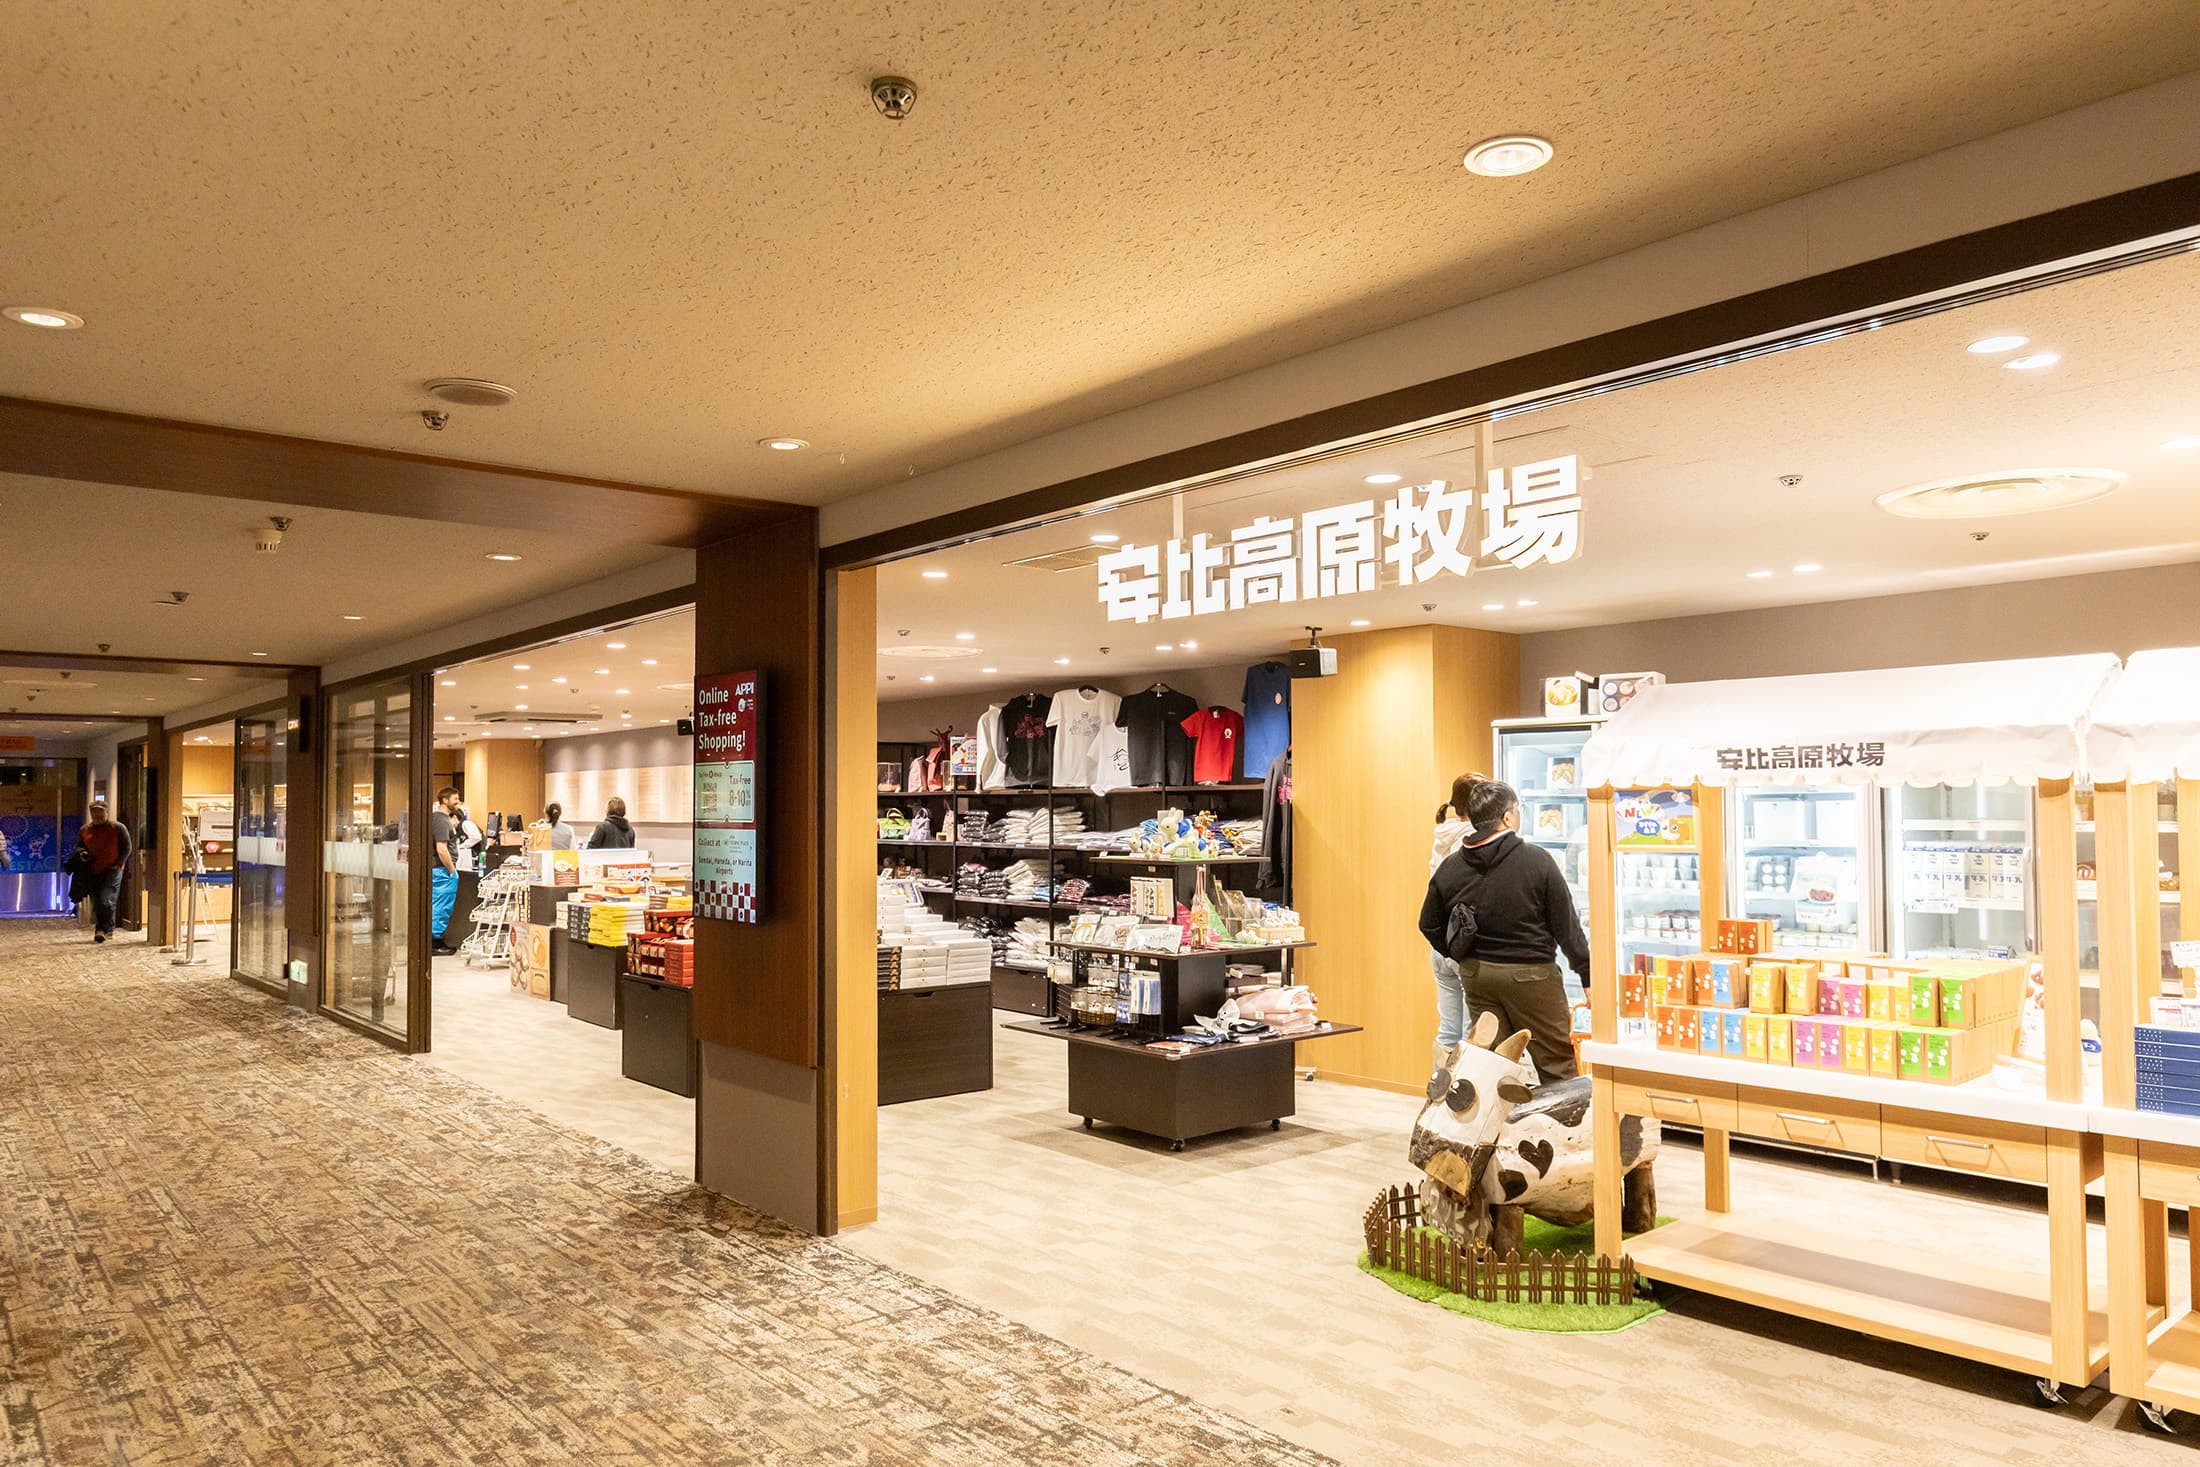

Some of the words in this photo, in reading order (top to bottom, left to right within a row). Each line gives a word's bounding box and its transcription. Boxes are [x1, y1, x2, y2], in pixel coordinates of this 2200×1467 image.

[1097, 454, 1582, 623] 安比高原牧場
[699, 687, 729, 705] Online
[735, 682, 754, 696] APPI
[699, 709, 737, 727] Tax-free
[699, 730, 746, 752] Shopping!
[1716, 742, 1886, 771] 安比高原牧場
[1624, 806, 1654, 819] NEW
[698, 837, 714, 847] Collect
[9, 860, 43, 872] ESTA
